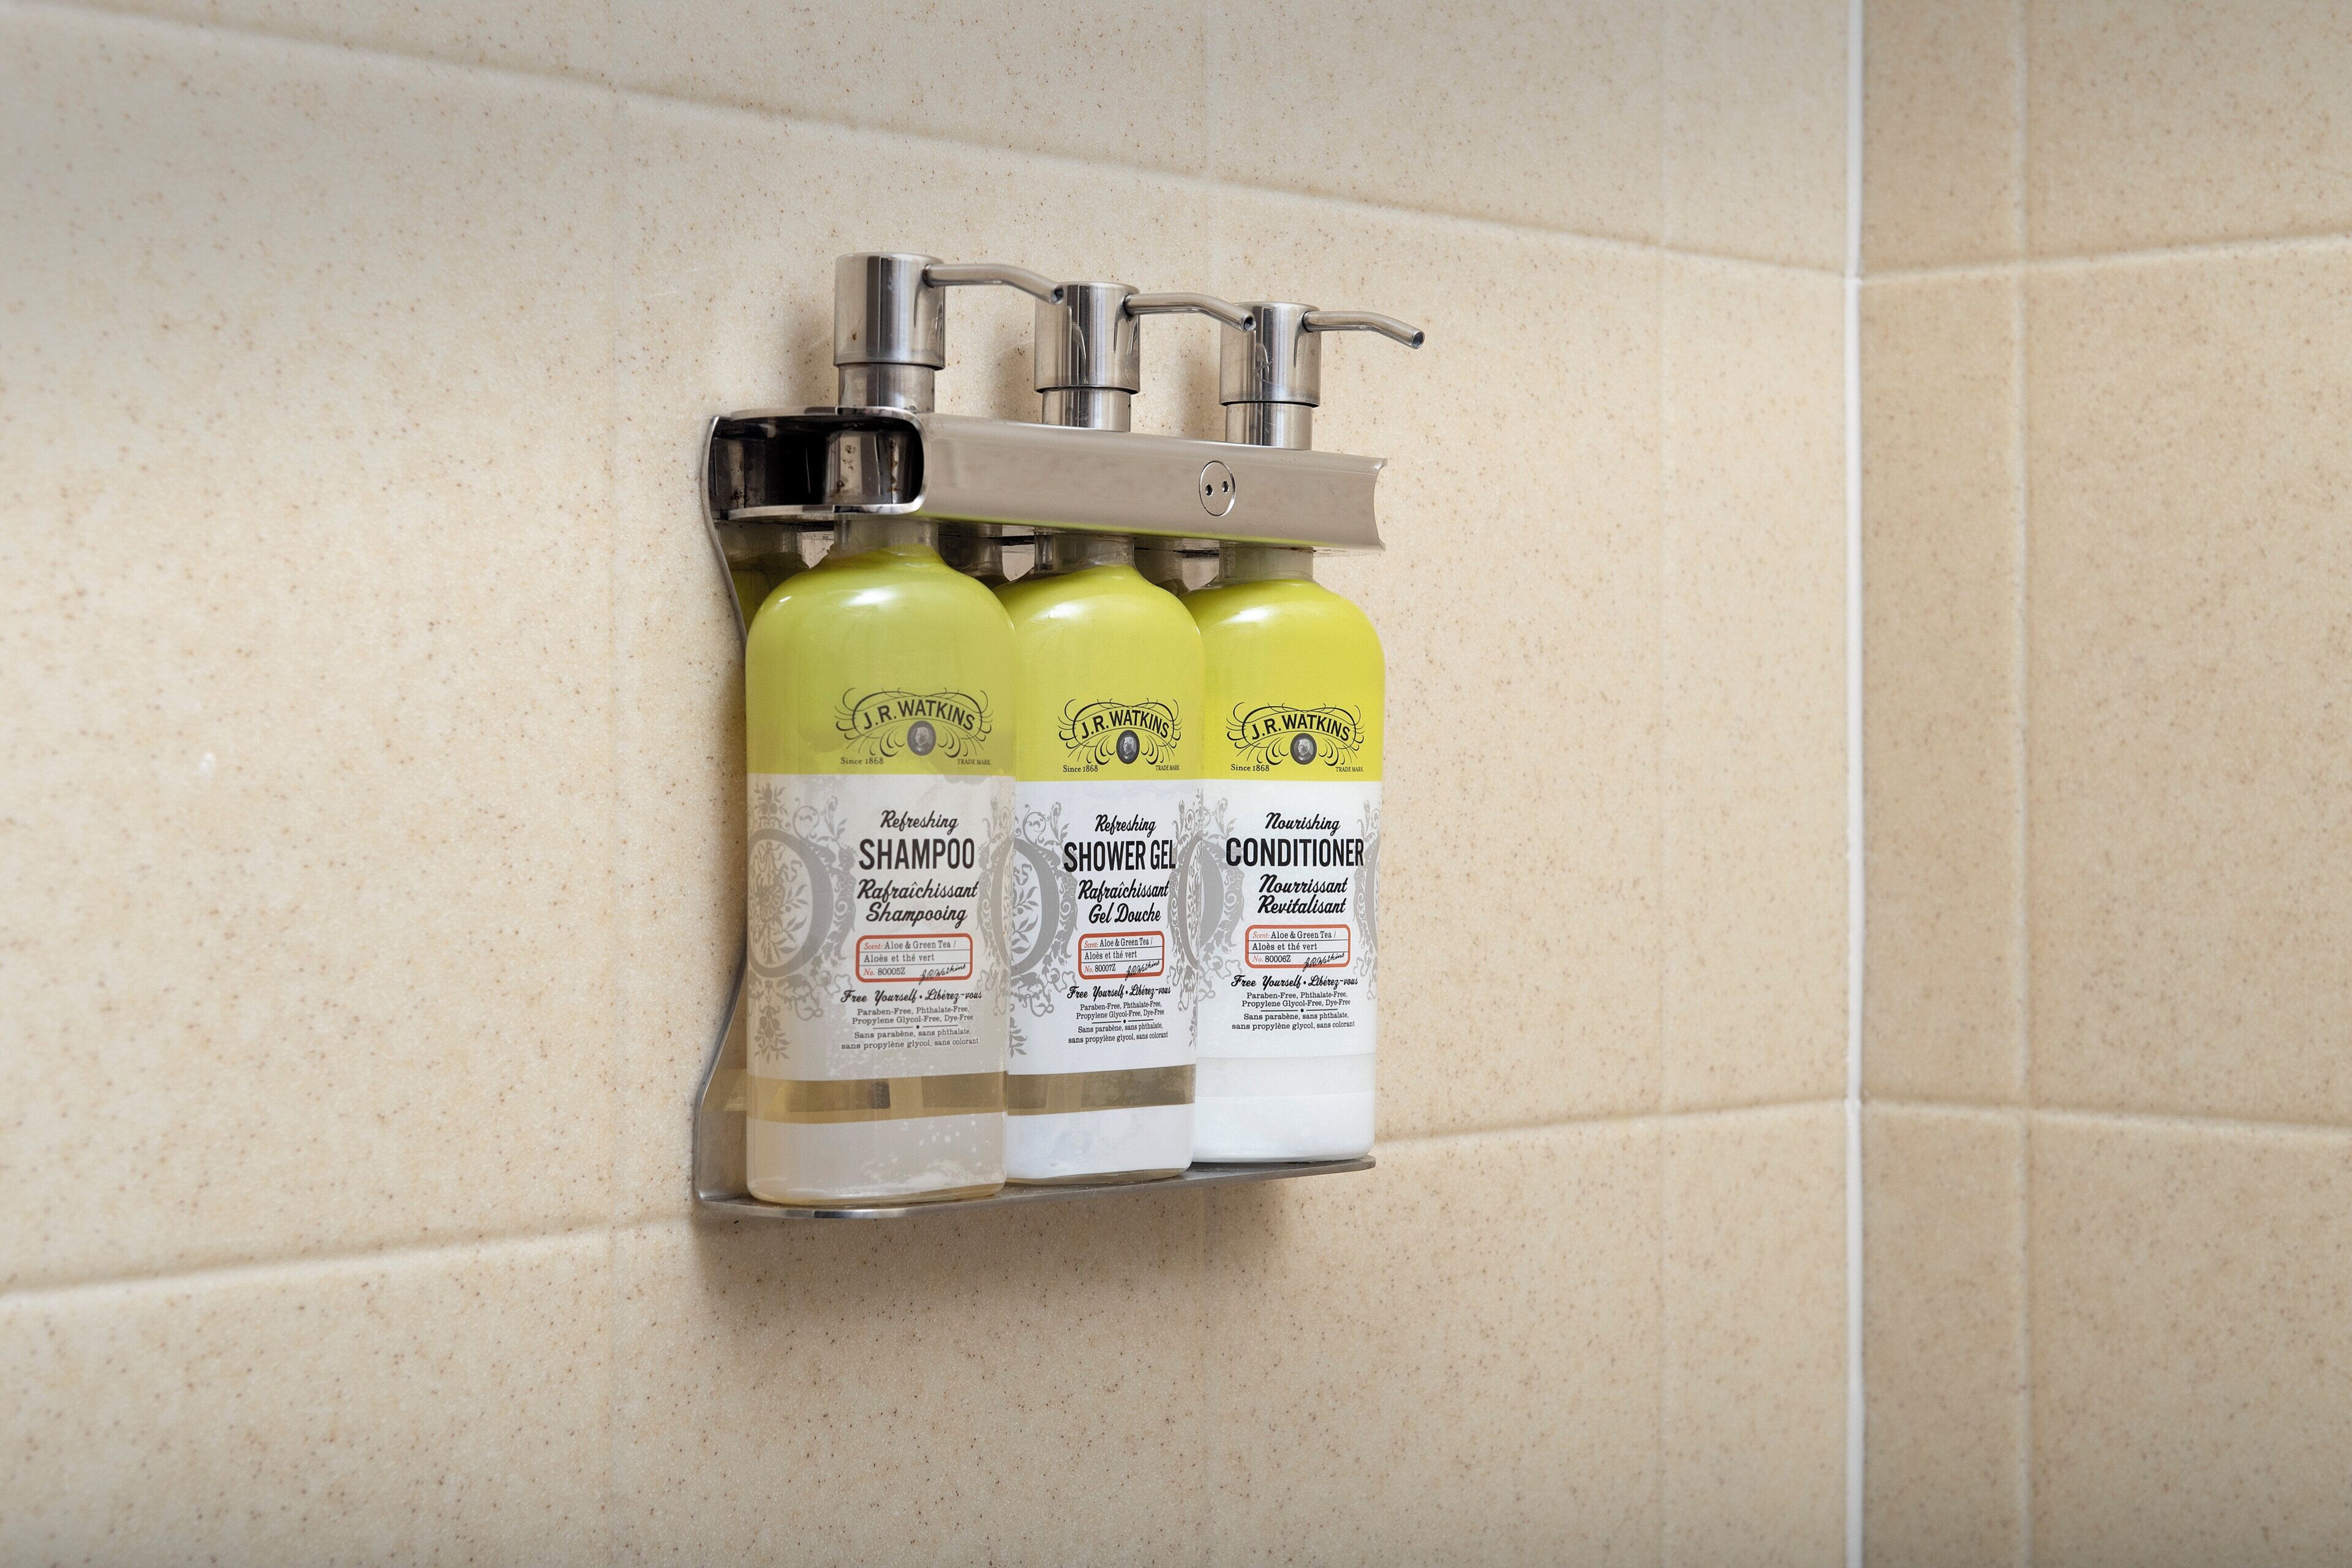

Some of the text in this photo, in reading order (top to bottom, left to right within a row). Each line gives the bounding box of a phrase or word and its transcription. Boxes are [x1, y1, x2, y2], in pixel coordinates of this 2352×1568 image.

[897, 699, 975, 731] WATKINS
[1109, 710, 1169, 738] WATKINS
[1281, 714, 1351, 741] WATKINS
[880, 810, 959, 835] Refreshing
[1095, 814, 1156, 837] Refreshing
[1265, 812, 1341, 836] Nourishing
[859, 839, 974, 870] SHAMPOO
[1064, 840, 1175, 872] SHOWER GEL
[1226, 837, 1364, 867] CONDITIONER
[857, 878, 979, 903] Rafraîchissant
[1078, 879, 1169, 903] Rafraîchissant
[1259, 873, 1348, 893] Nourrissant
[1089, 902, 1161, 924] Gel Douche
[1257, 894, 1347, 914] Revitalisant
[866, 902, 968, 929] Shampooing
[864, 953, 888, 963] Aloès
[903, 953, 915, 962] thé
[877, 967, 905, 976] 80005Z
[1231, 974, 1358, 990] Free Yourself Libérez-vous
[840, 989, 982, 1006] Free Yourself Libérez-vous
[1067, 984, 1170, 1001] Free Yourself Libérez-vous
[858, 1007, 914, 1016] Paraben-Free,
[1076, 1012, 1107, 1020] Propylene
[1109, 1010, 1142, 1019] Glycol-Free,
[1080, 1003, 1121, 1011] Paraben-Free,
[896, 1016, 942, 1024] Glycol-Free,
[1095, 1024, 1123, 1033] parabène,
[1139, 1022, 1163, 1031] phthalate,
[877, 1030, 915, 1039] parabène,
[1085, 1035, 1115, 1044] propylène
[1117, 1034, 1135, 1042] glycol,
[863, 1041, 904, 1050] propylène
